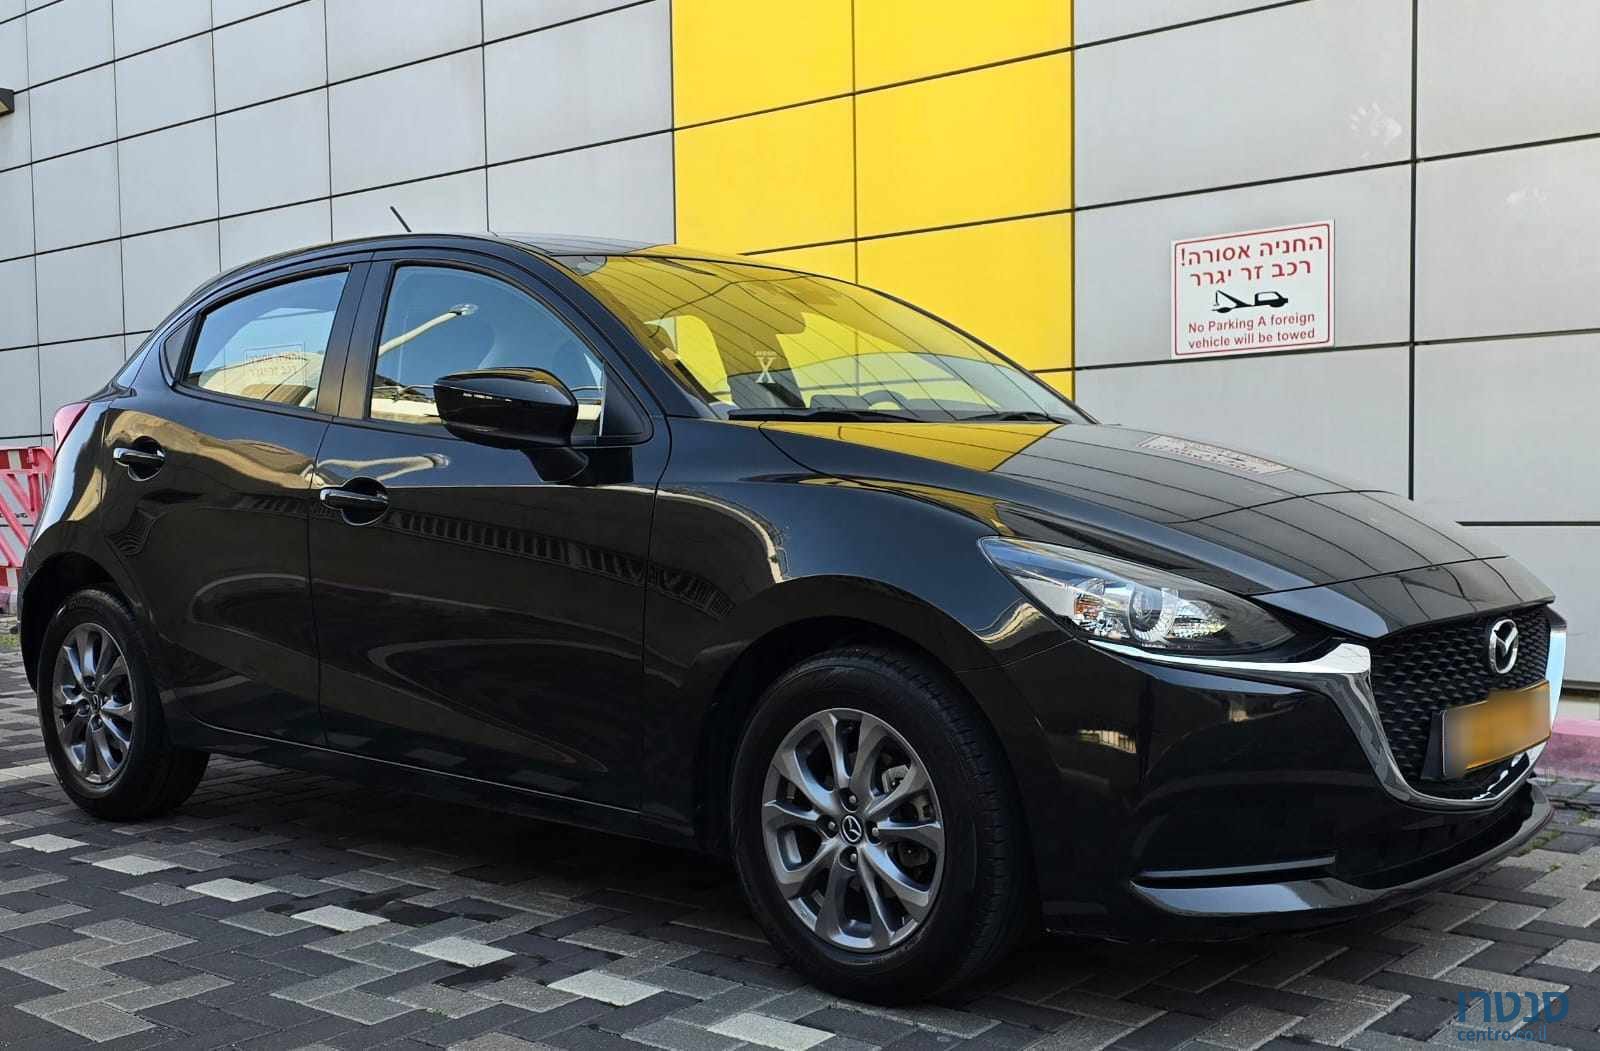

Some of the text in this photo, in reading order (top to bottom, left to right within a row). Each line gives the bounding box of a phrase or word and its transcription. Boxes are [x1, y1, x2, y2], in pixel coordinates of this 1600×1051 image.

[1181, 236, 1322, 266] החניה אסורה!
[1190, 260, 1311, 286] רכב זר יגרר
[1188, 312, 1315, 333] No Parking A foreign
[1188, 328, 1315, 349] vehicle will be towed
